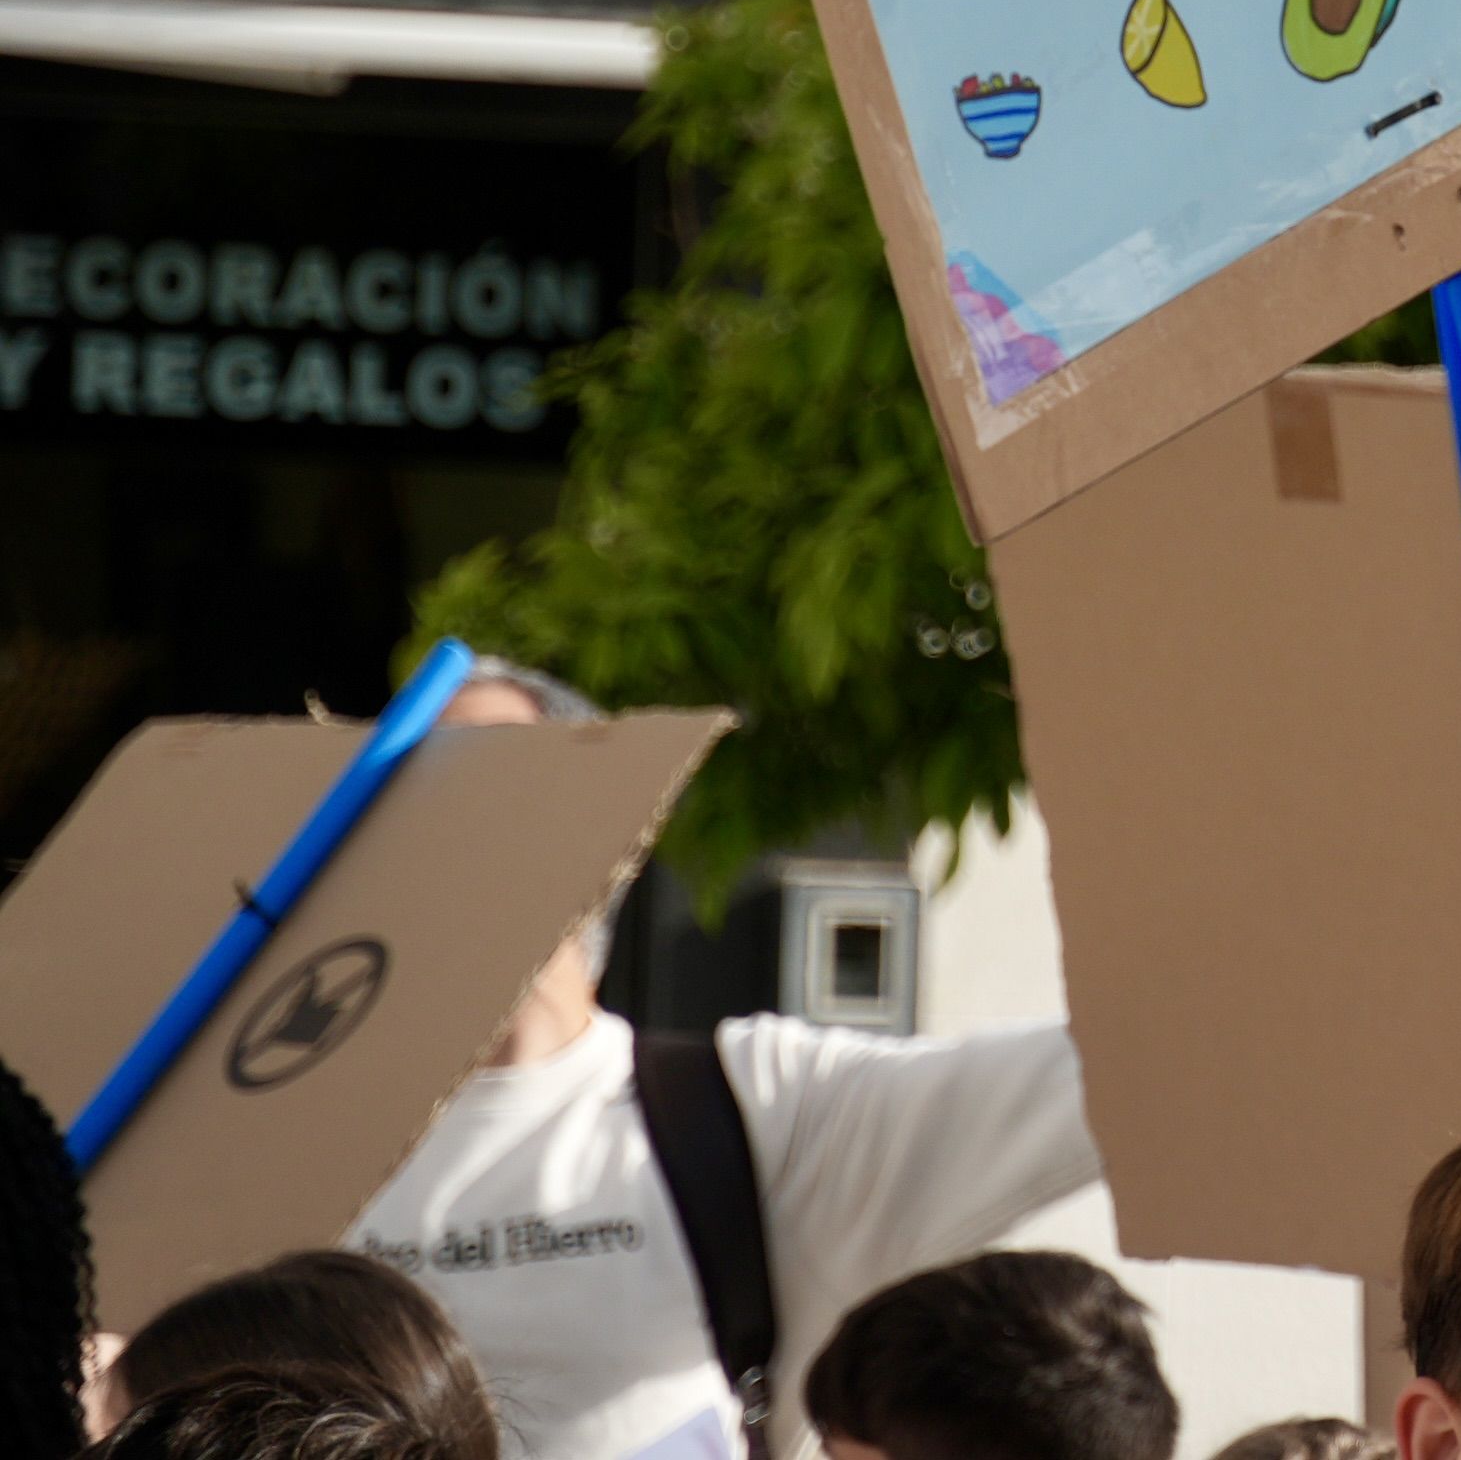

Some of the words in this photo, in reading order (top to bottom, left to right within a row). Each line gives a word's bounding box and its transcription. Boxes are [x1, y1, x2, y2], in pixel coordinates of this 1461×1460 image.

[0, 232, 600, 340] ECORACIÓN
[0, 328, 48, 412] Y
[69, 329, 548, 433] REGALOS
[430, 1220, 497, 1275] del
